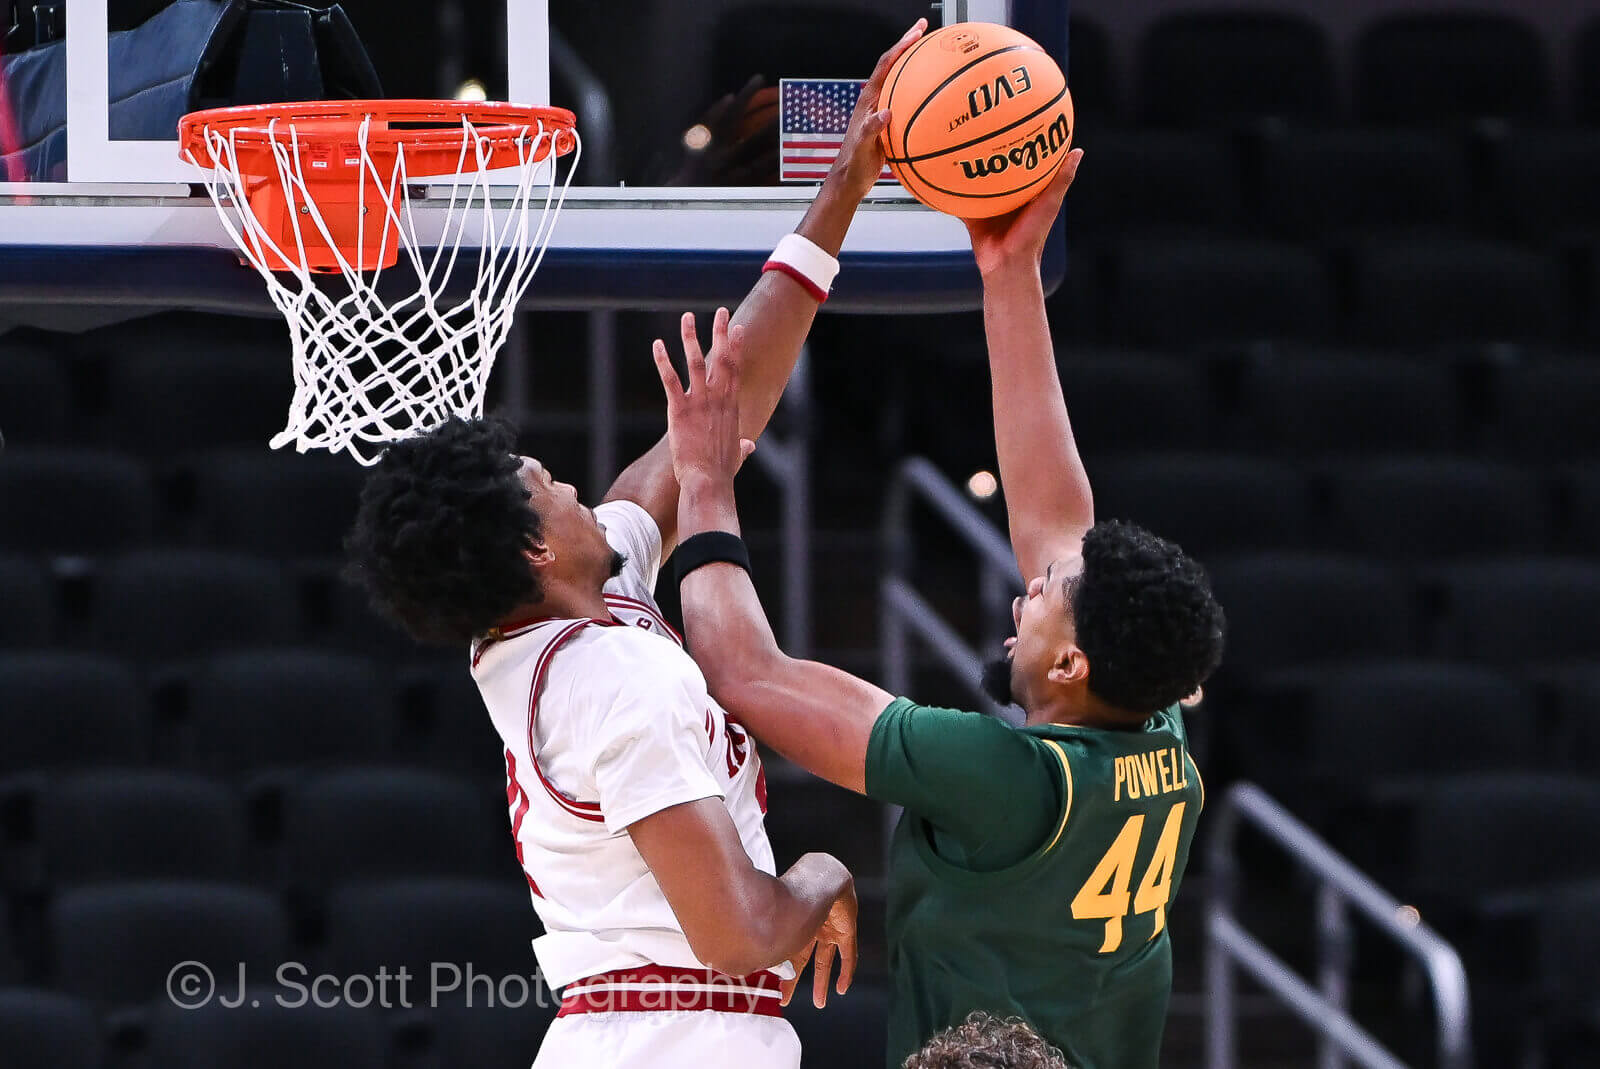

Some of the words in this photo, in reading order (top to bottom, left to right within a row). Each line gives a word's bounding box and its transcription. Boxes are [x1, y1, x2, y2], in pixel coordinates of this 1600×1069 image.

[946, 112, 970, 133] NXT
[959, 112, 1070, 180] Wilson
[1113, 743, 1189, 803] POWELL
[1070, 801, 1187, 954] 44
